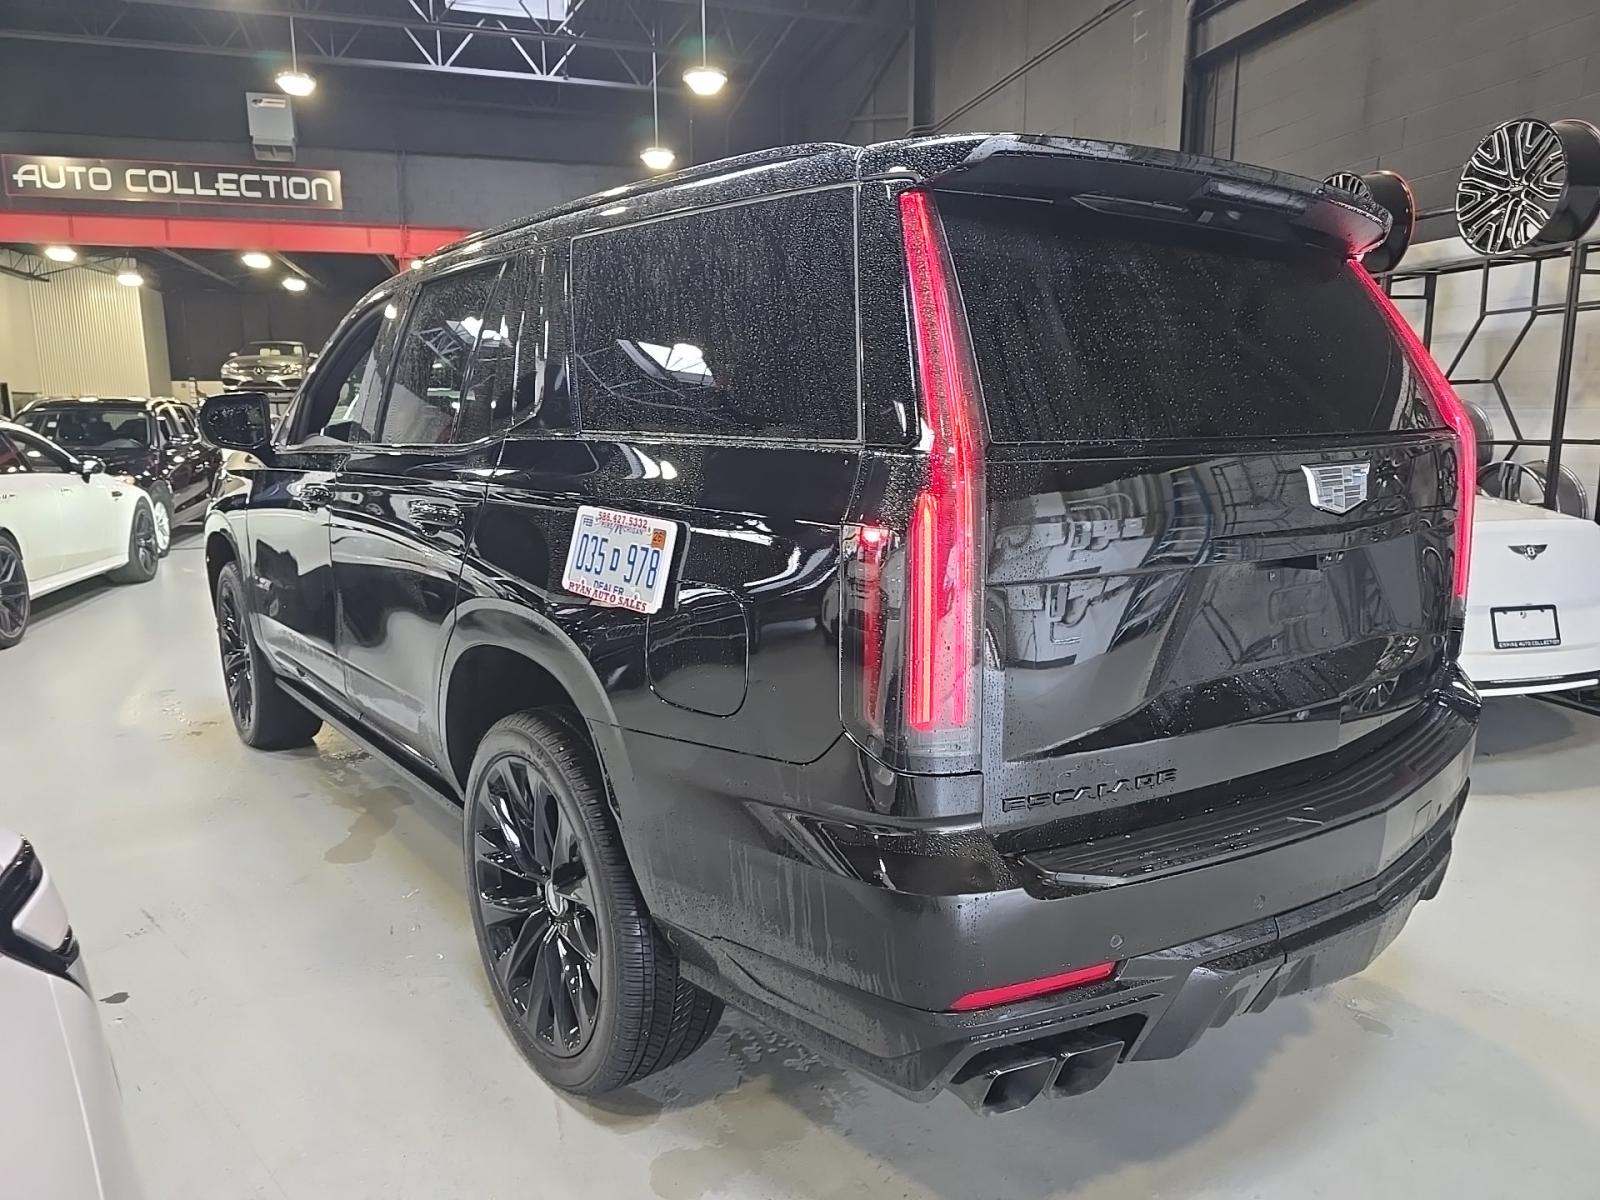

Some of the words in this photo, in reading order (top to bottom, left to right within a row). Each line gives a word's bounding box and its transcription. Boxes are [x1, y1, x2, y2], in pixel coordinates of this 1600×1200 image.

[12, 164, 112, 191] AUTO
[125, 168, 333, 201] COLLECTION
[576, 533, 608, 575] 035
[609, 548, 620, 571] D
[623, 544, 660, 589] 978
[568, 581, 592, 595] RYAN
[592, 590, 616, 603] AUTO
[618, 596, 647, 611] SALES
[593, 580, 624, 595] DEALER
